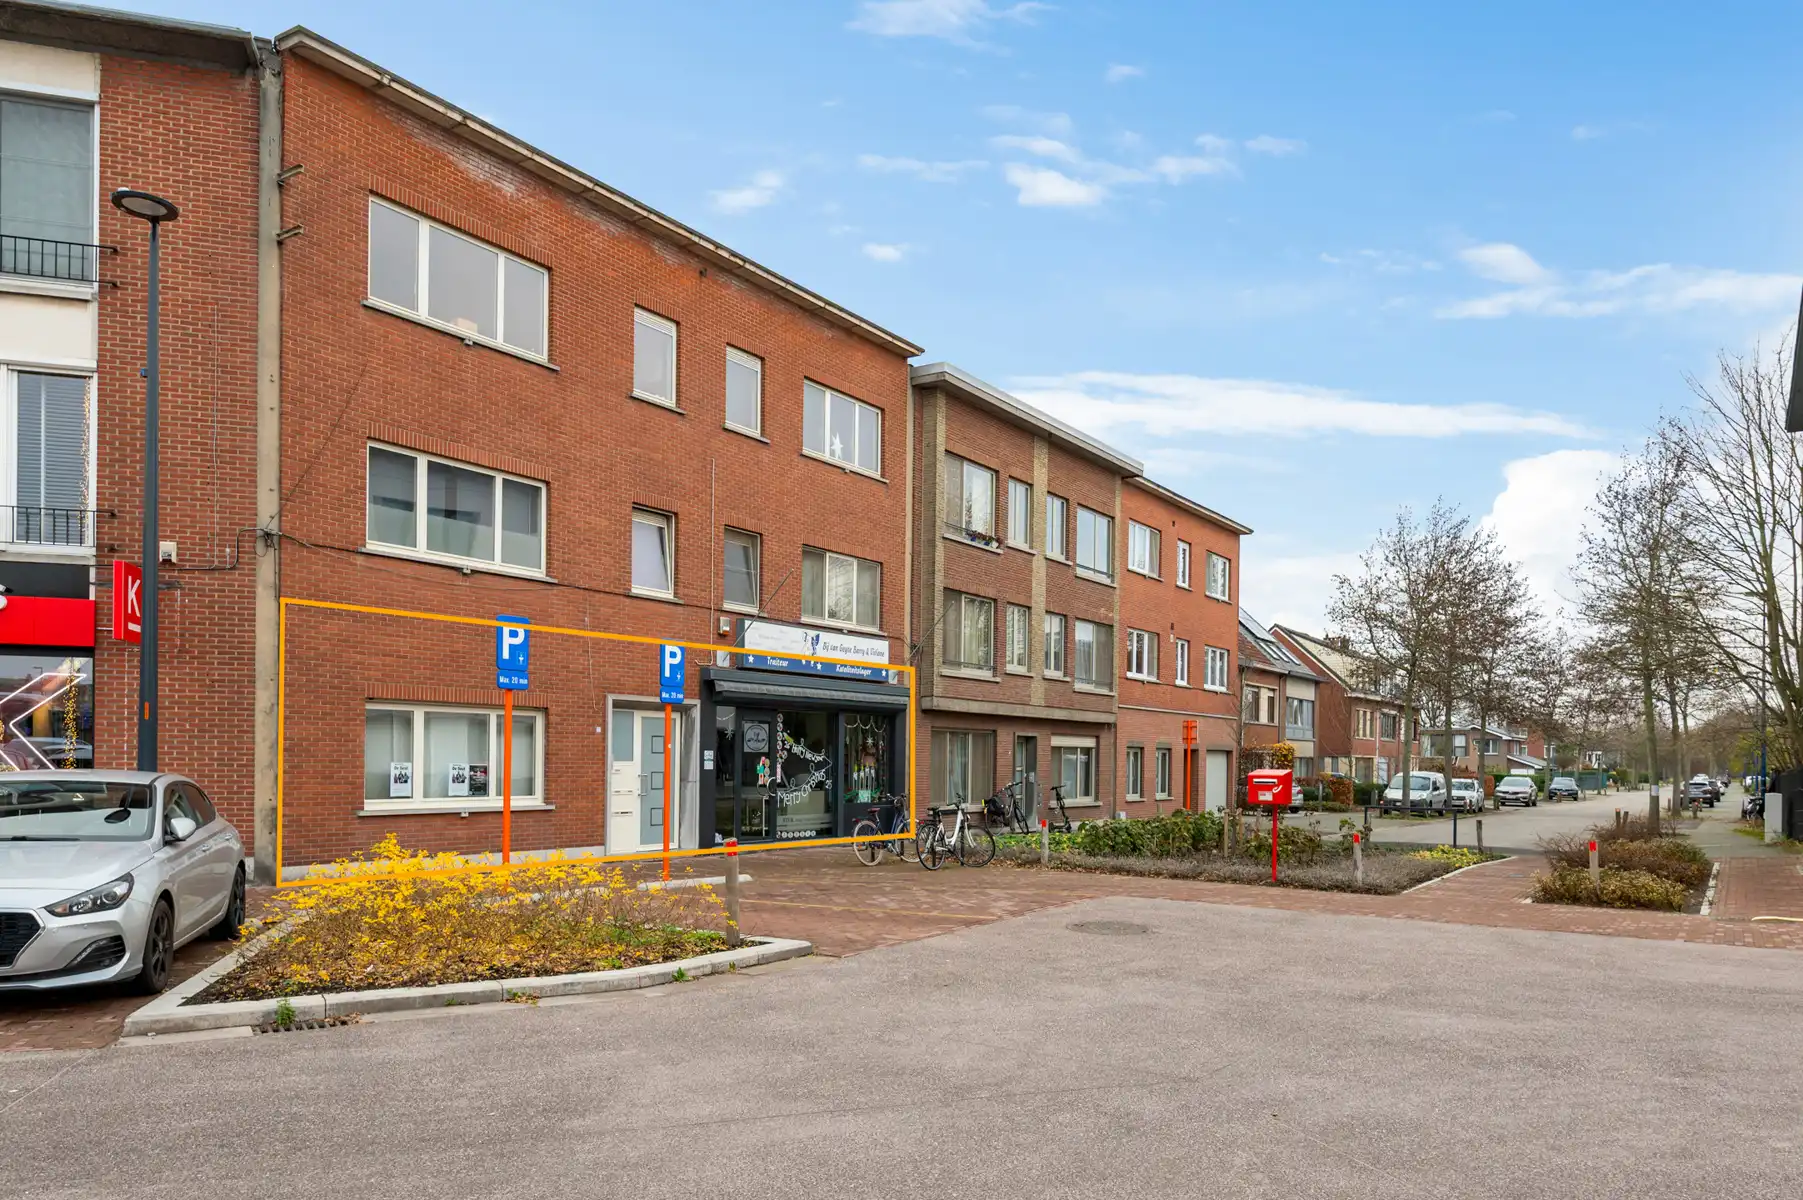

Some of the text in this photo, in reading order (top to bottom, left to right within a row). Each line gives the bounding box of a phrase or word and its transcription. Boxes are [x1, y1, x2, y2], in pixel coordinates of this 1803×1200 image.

[128, 575, 141, 618] K
[502, 624, 525, 660] P
[664, 644, 682, 678] P
[766, 656, 789, 668] Traiteur
[511, 676, 519, 685] 20
